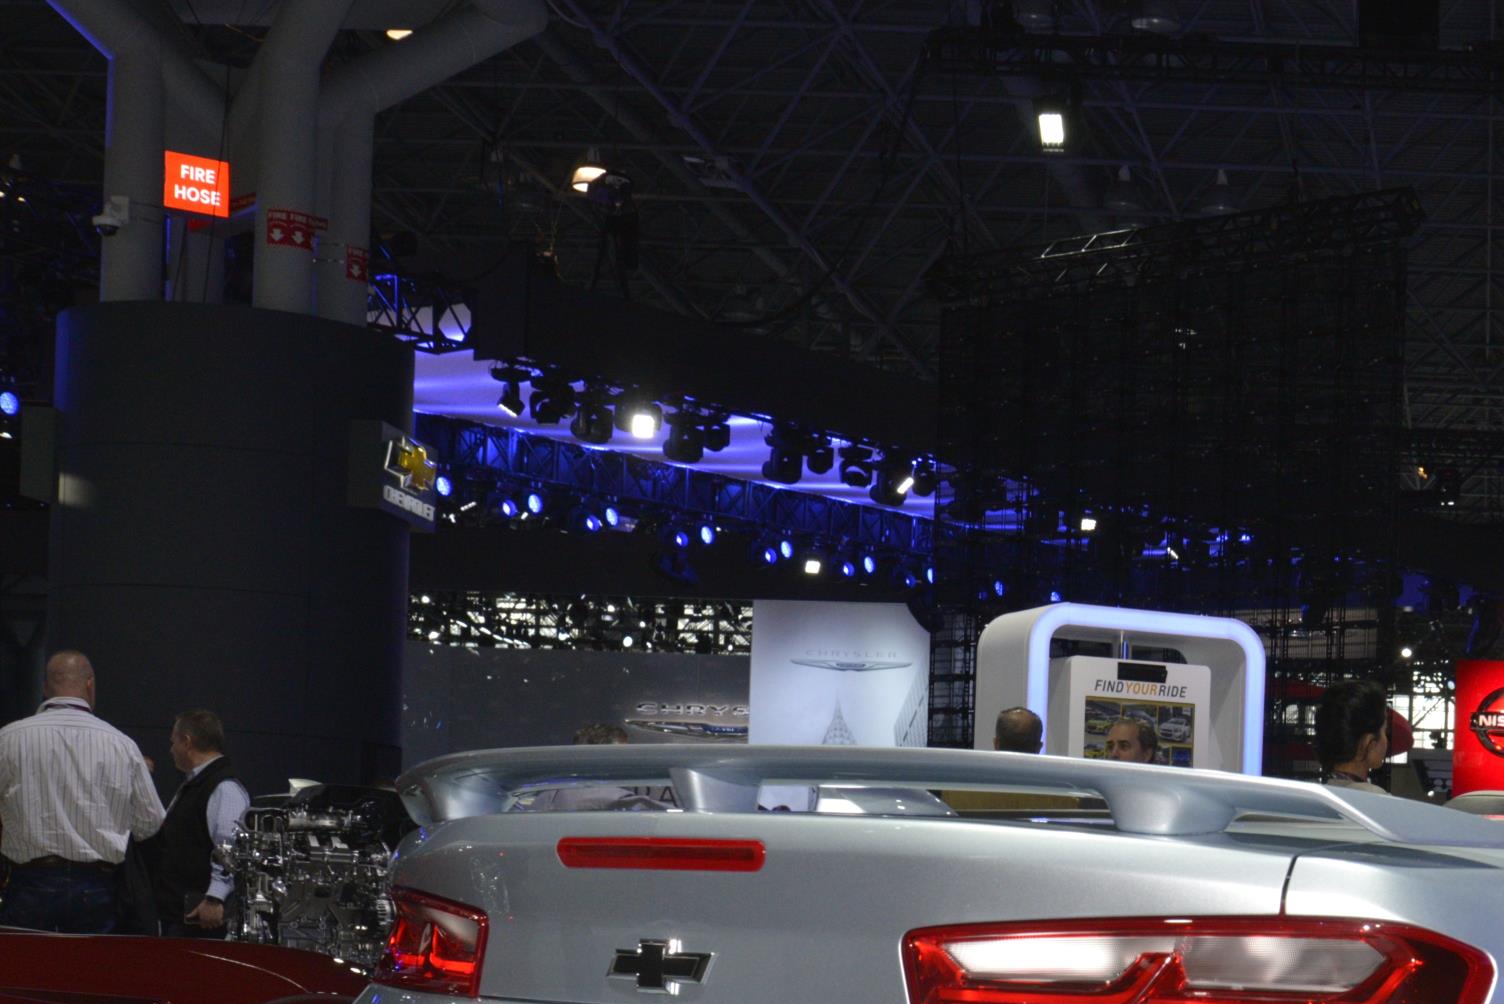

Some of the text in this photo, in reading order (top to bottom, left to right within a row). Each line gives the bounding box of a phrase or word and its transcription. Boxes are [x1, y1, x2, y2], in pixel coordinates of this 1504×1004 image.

[180, 164, 216, 184] FIRE
[174, 184, 221, 206] HOSE
[805, 649, 897, 659] CHRYSLER
